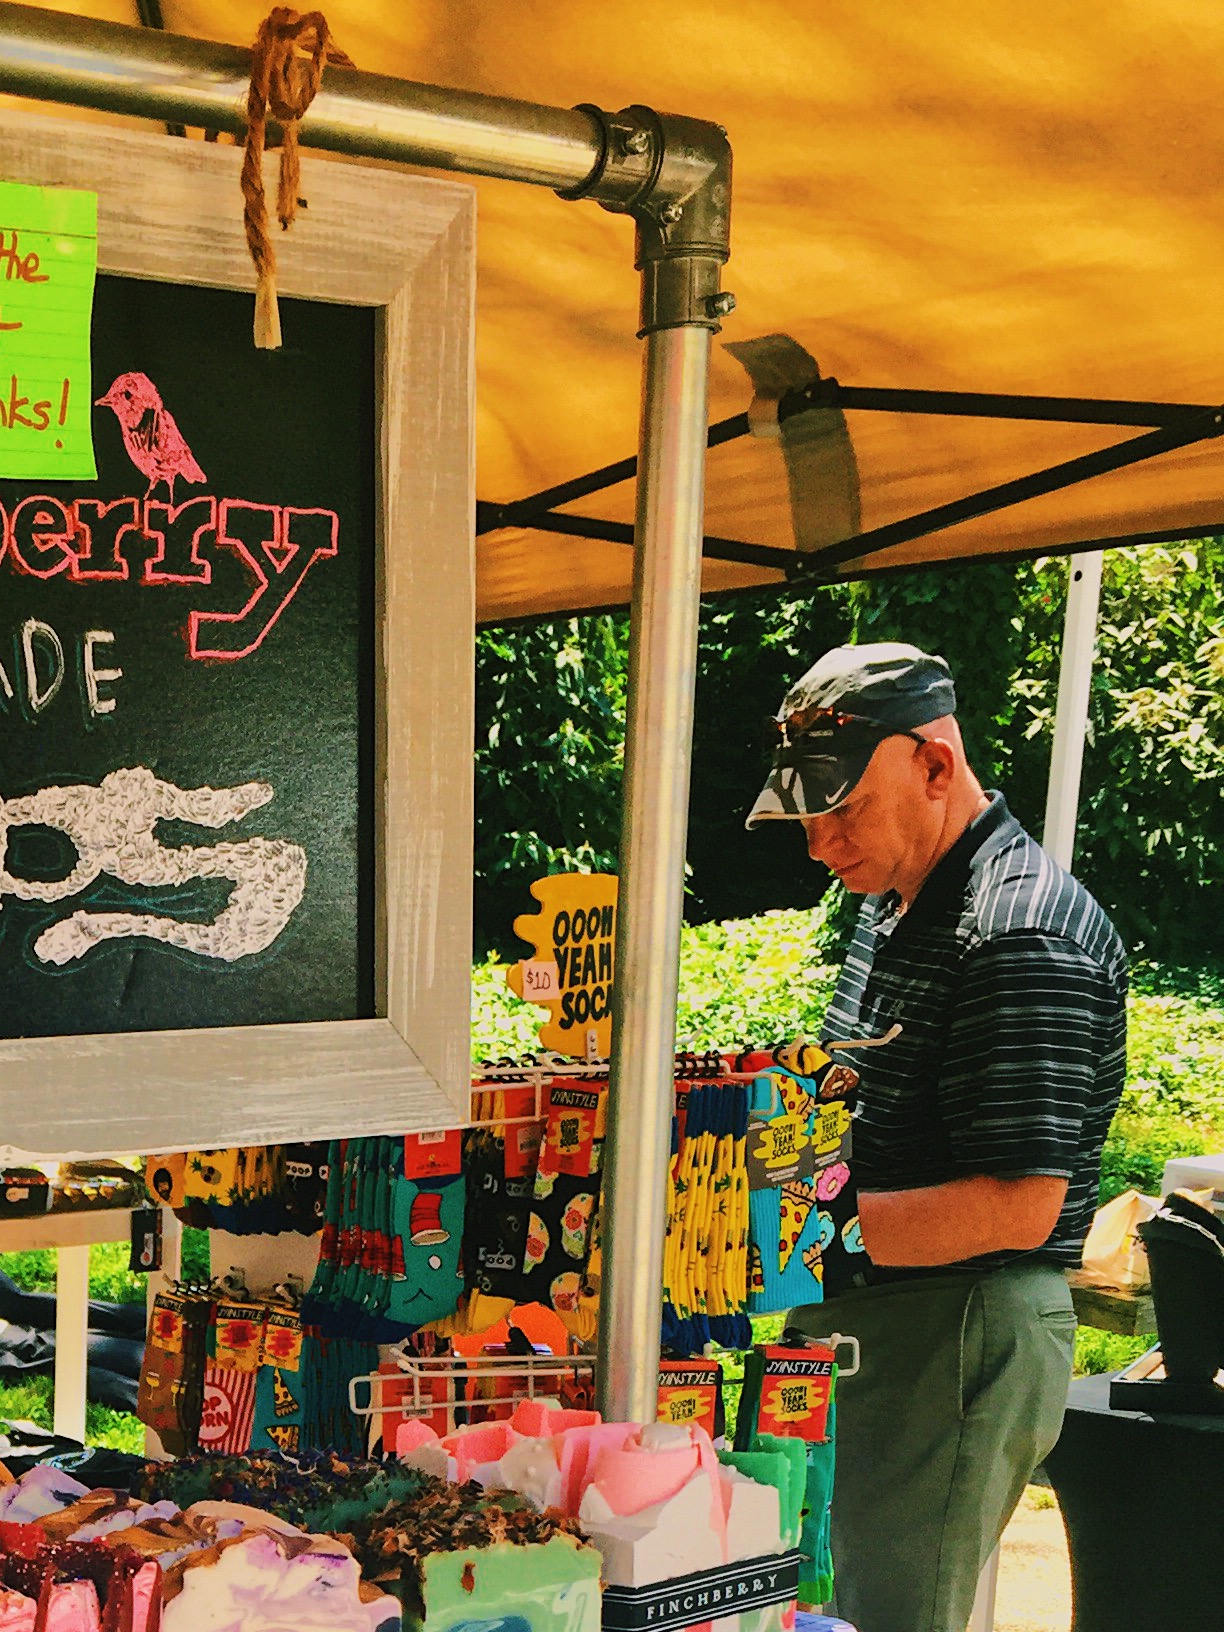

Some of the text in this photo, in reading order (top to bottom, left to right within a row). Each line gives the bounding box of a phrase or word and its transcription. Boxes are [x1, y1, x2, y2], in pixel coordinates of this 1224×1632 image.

[552, 905, 614, 947] OOOH
[526, 967, 552, 991] $10
[552, 942, 612, 990] YEAH
[646, 1574, 778, 1620] FINCHBERRY
